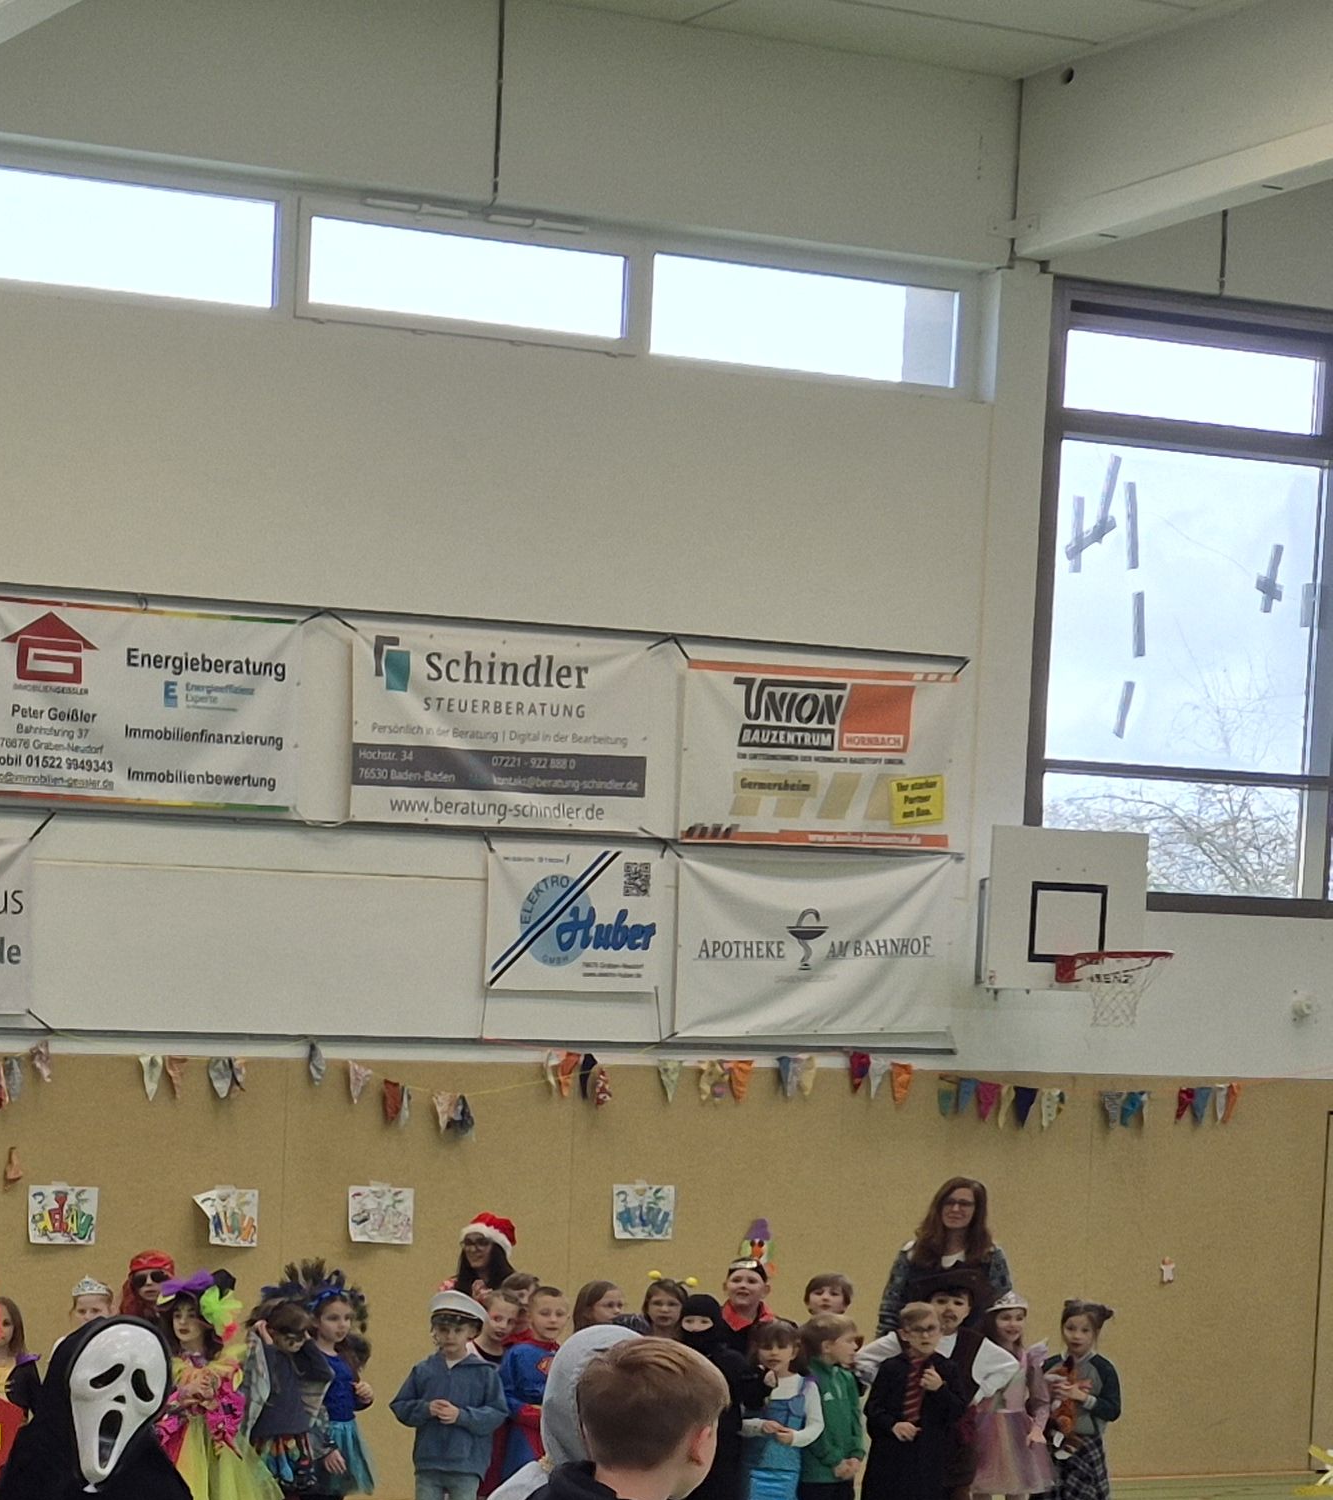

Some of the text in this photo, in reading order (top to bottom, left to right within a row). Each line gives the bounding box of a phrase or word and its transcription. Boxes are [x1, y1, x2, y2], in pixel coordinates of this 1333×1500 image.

[126, 647, 287, 683] Energieberatung
[425, 651, 589, 689] Schindler
[11, 703, 98, 723] Peter Geißler
[423, 697, 587, 719] STEUERBERATUNG
[733, 677, 848, 726] UNION
[125, 724, 284, 751] Immobilienfinanzierung
[371, 722, 424, 736] Persönlich
[452, 728, 499, 744] Beratung
[509, 730, 540, 744] Digital
[553, 732, 569, 742] der
[571, 733, 629, 748] Bearbeitung
[741, 728, 833, 747] BAUZENTRUM
[845, 736, 902, 748] HORNBACH
[358, 749, 414, 762] Hochstr. 34
[491, 755, 521, 767] 07221
[127, 767, 277, 792] Immobilienbewertung
[358, 768, 456, 783] 76530 Baden-Baden
[740, 777, 812, 792] Germersheim
[389, 796, 605, 822] www.beratung-schindler.de
[520, 874, 570, 925] ELEKTRO
[556, 905, 657, 953] Huber
[698, 935, 933, 959] APOTHEKE AM BAHNHOF
